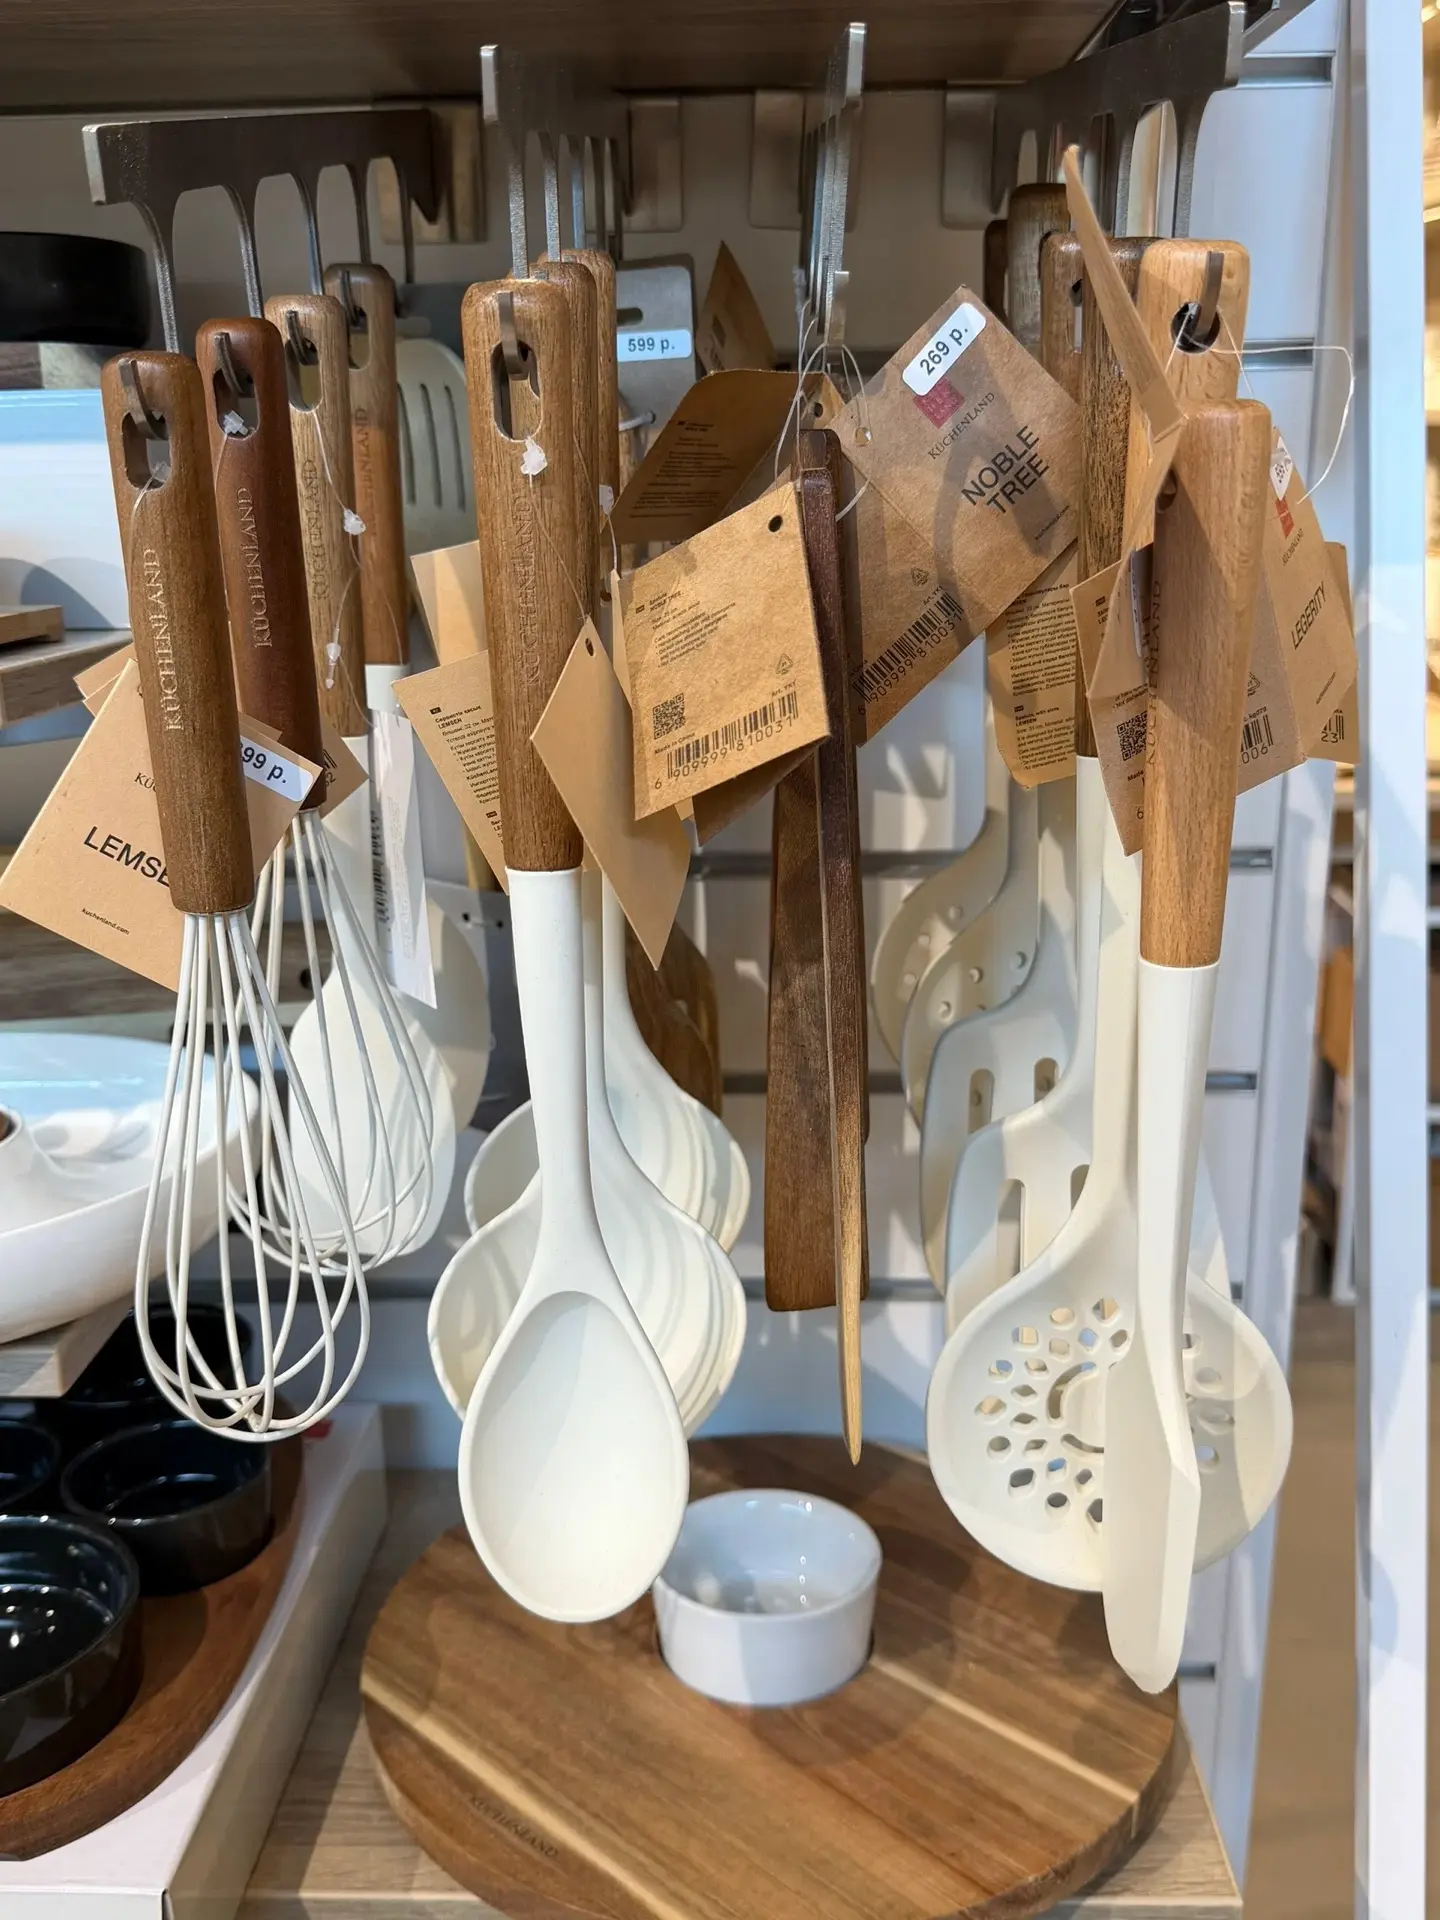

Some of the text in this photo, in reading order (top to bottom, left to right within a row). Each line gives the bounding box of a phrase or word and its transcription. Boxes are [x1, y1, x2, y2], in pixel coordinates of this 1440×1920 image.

[628, 338, 655, 352] 599
[920, 341, 950, 376] 269
[961, 425, 1040, 506] NOBLE
[986, 453, 1050, 514] TREE
[143, 548, 184, 731] KÜCHENLAND
[1291, 581, 1326, 650] LEGERITY
[870, 658, 914, 702] 909999
[916, 613, 962, 658] 810031
[240, 741, 266, 769] 99
[654, 716, 794, 790] 6 909999 810031
[83, 826, 170, 888] LEMSE
[82, 908, 130, 935] kuchenland.com
